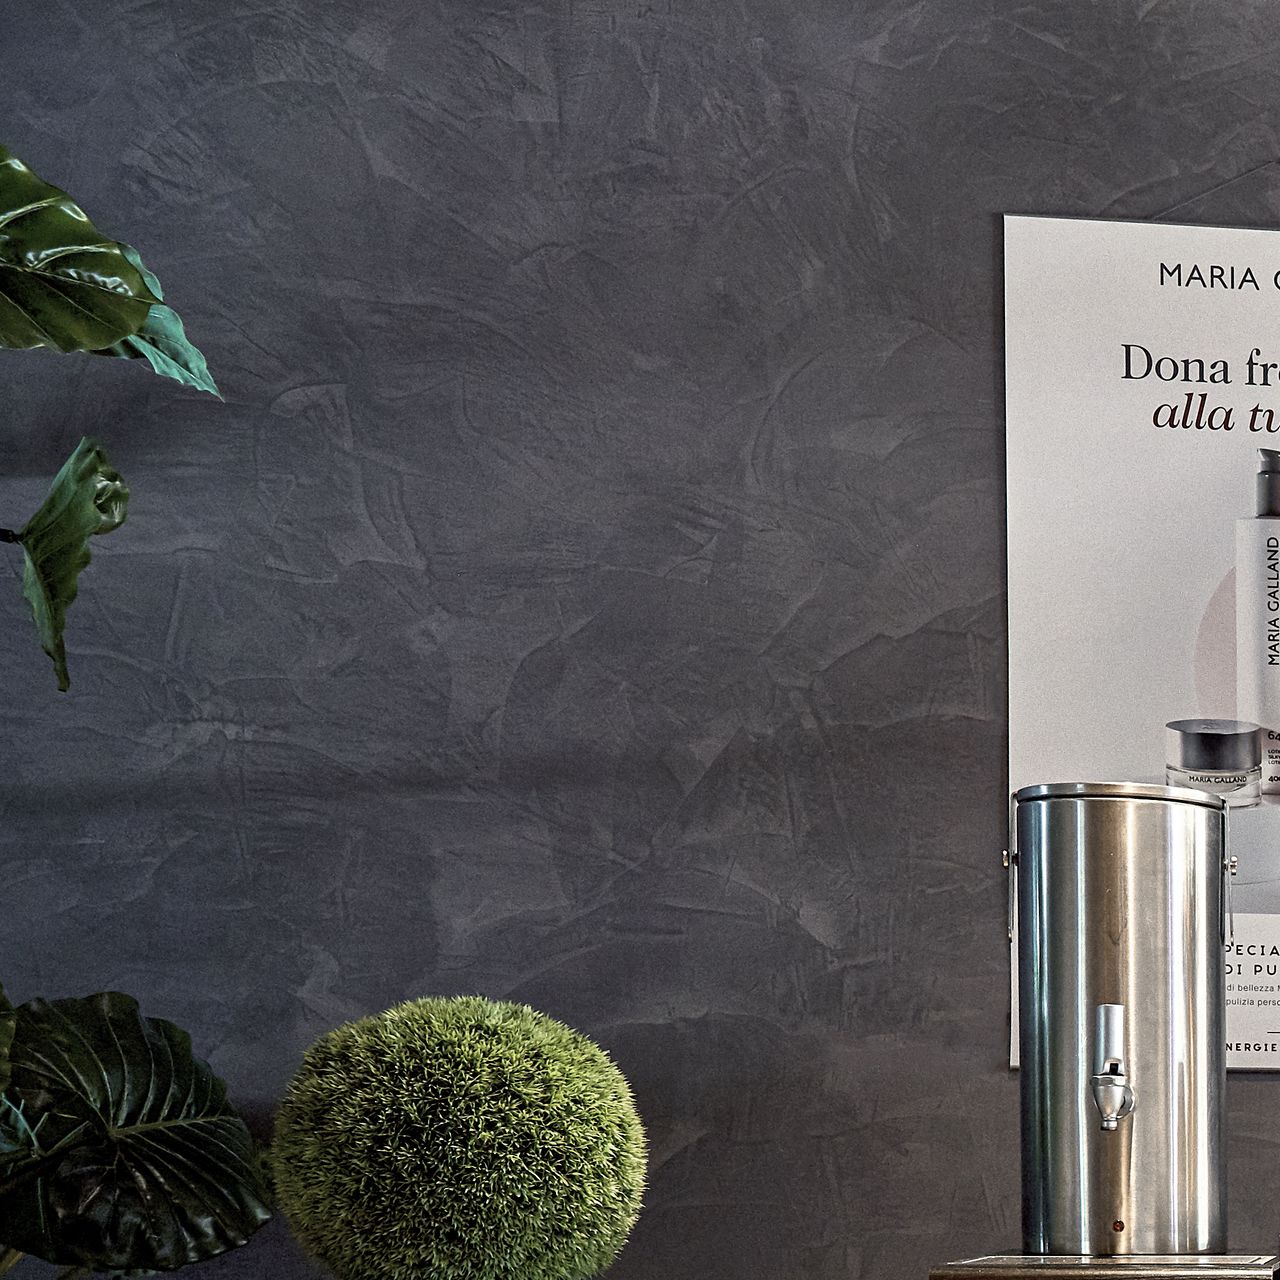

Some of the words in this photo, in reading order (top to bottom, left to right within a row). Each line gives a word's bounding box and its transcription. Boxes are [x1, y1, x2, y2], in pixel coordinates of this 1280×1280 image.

[1159, 262, 1260, 291] MARIA
[1120, 343, 1233, 385] Dona
[1152, 392, 1236, 431] alla
[1266, 536, 1280, 612] GALLAND
[1267, 617, 1280, 666] MARIA
[1214, 776, 1247, 784] GALLAND
[1225, 964, 1242, 975] DI
[1226, 984, 1235, 992] di
[1237, 984, 1275, 993] bellezza
[1226, 998, 1255, 1008] pulizia
